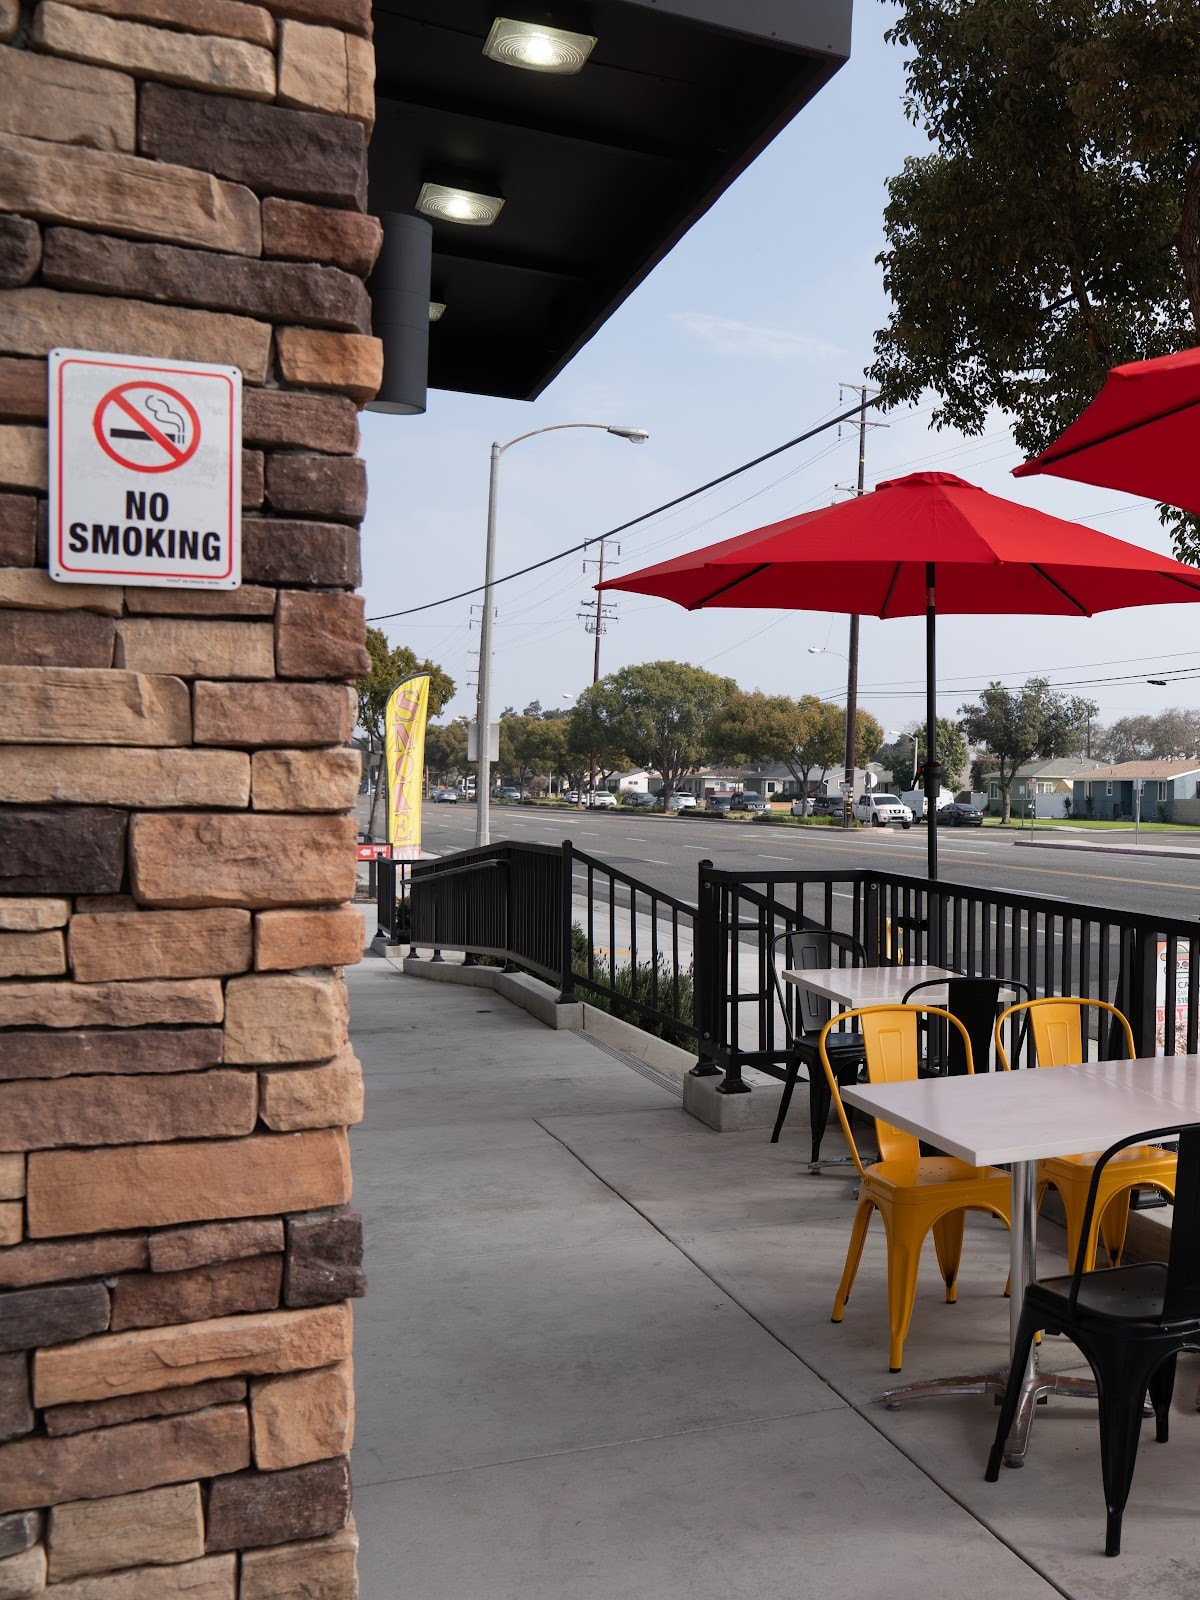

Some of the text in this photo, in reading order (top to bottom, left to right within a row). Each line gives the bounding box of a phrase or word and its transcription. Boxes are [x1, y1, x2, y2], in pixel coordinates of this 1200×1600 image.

[126, 490, 169, 522] NO
[69, 523, 221, 561] SMOKING
[392, 690, 420, 842] SMOKE
